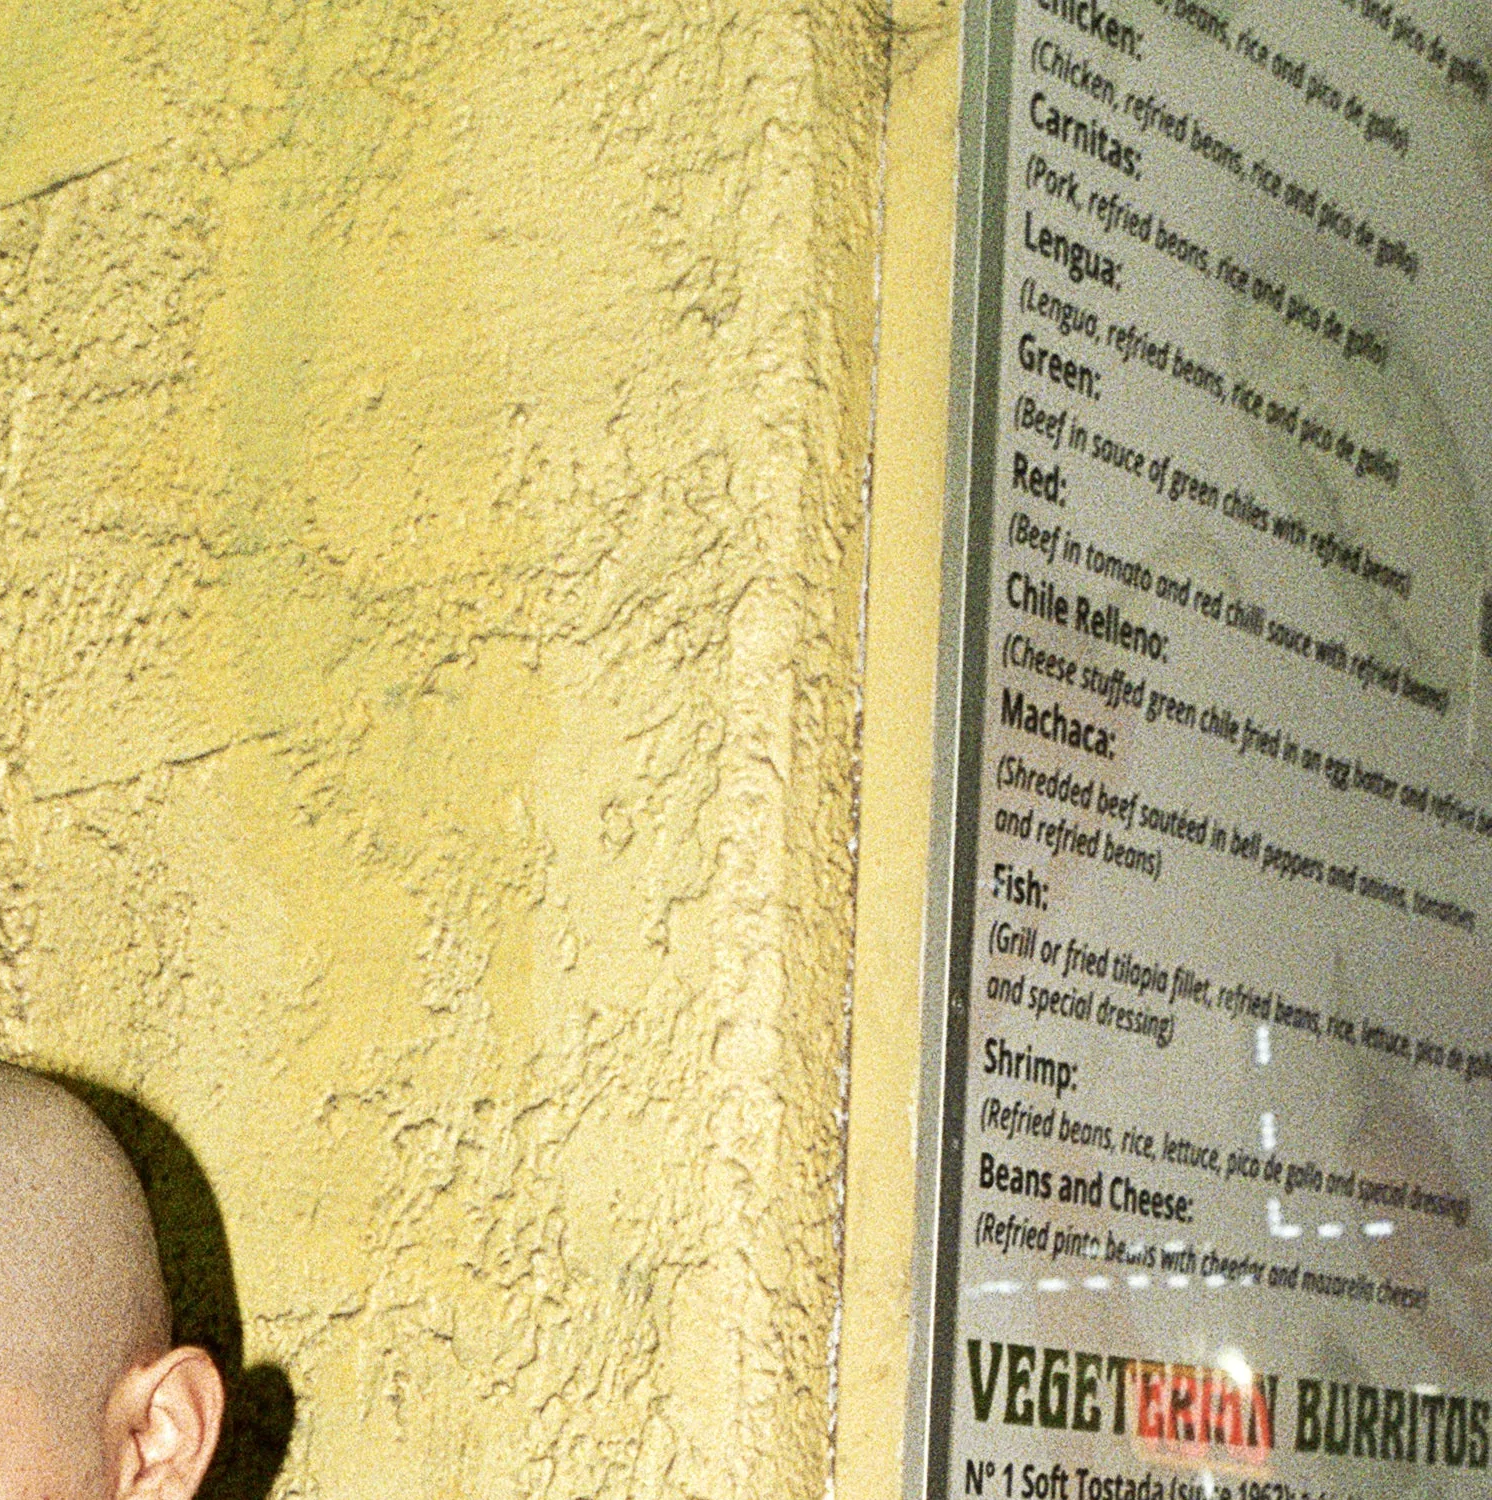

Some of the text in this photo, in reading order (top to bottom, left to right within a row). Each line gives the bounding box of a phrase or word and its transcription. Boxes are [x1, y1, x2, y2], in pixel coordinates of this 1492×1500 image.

[1032, 39, 1118, 111] (Chicken,
[1030, 92, 1141, 180] Carnitas:
[1026, 154, 1082, 211] (Pork,
[1089, 192, 1153, 242] refried
[1025, 211, 1122, 291] Lengua:
[1020, 279, 1100, 343] (Lengua,
[1107, 325, 1170, 371] refried
[1019, 333, 1100, 400] Green:
[1015, 396, 1067, 450] (Beef
[1069, 418, 1088, 451] in
[1091, 434, 1145, 477] sauce
[1013, 452, 1066, 502] Red:
[1009, 513, 1061, 564] (Beef
[1062, 532, 1081, 565] in
[1086, 545, 1152, 592] tomato
[1007, 572, 1168, 659] Chile Relleno:
[1003, 635, 1077, 685] (Cheese
[1081, 667, 1145, 709] stuffed
[1002, 688, 1115, 759] Machaca:
[997, 755, 1094, 810] (Shredded
[995, 809, 1033, 840] and
[1037, 819, 1101, 858] refried
[993, 863, 1048, 910] Fish:
[989, 922, 1037, 958] (Grill
[1040, 940, 1062, 965] or
[1062, 938, 1109, 978] fried
[987, 976, 1025, 1005] and
[1028, 986, 1094, 1020] special
[984, 1037, 1077, 1098] Shrimp:
[981, 1098, 1056, 1139] (Refried
[1058, 1112, 1114, 1151] beans,
[980, 1153, 1193, 1223] Beans and Cheese:
[976, 1213, 1050, 1254] (Refried
[1296, 1380, 1491, 1468] BURRITOS
[1003, 1463, 1013, 1497] 1
